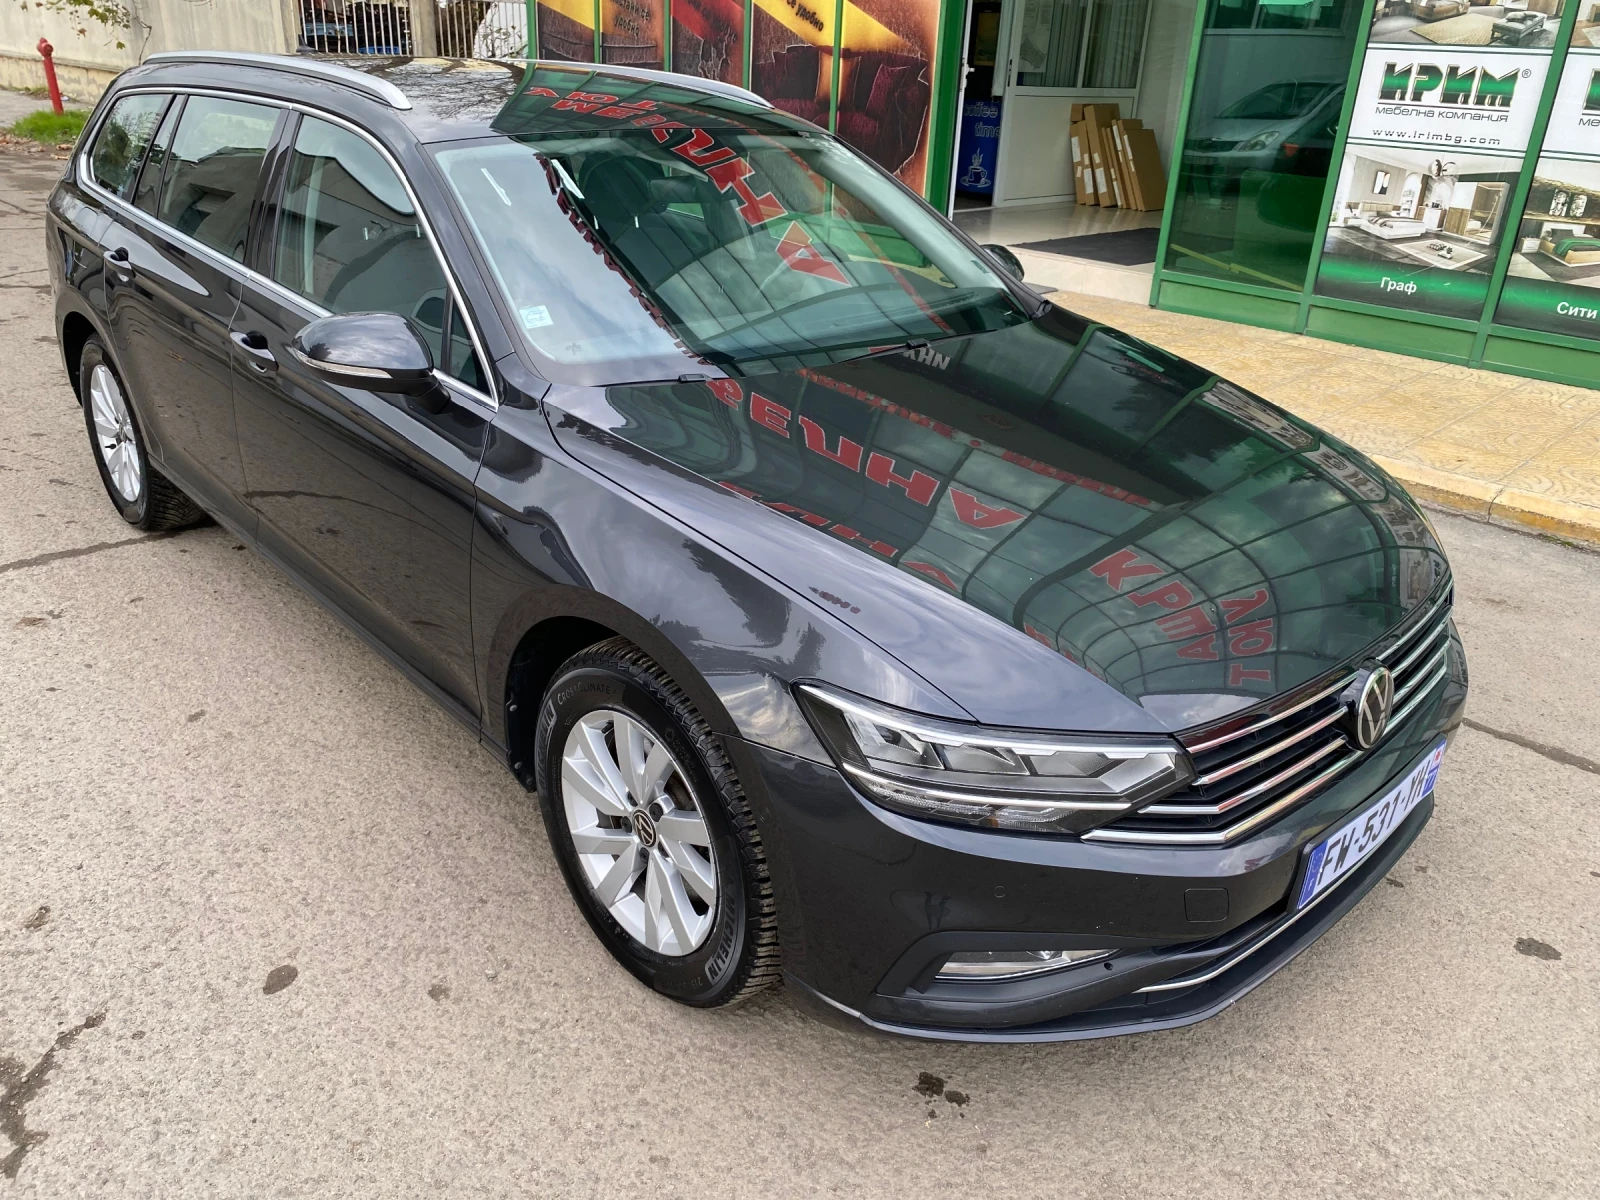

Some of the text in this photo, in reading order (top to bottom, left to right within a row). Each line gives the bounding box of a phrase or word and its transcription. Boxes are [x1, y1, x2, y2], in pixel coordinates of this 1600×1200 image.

[614, 15, 640, 36] удобно
[795, 4, 824, 32] удобно
[963, 101, 999, 118] coffee
[1375, 106, 1509, 123] мебелна компания
[1372, 129, 1501, 146] www.irimbg.com
[1380, 276, 1417, 296] Граф
[1556, 301, 1598, 319] Сити
[1317, 759, 1431, 886] FW-531-YH
[708, 891, 737, 981] MICHELIN
